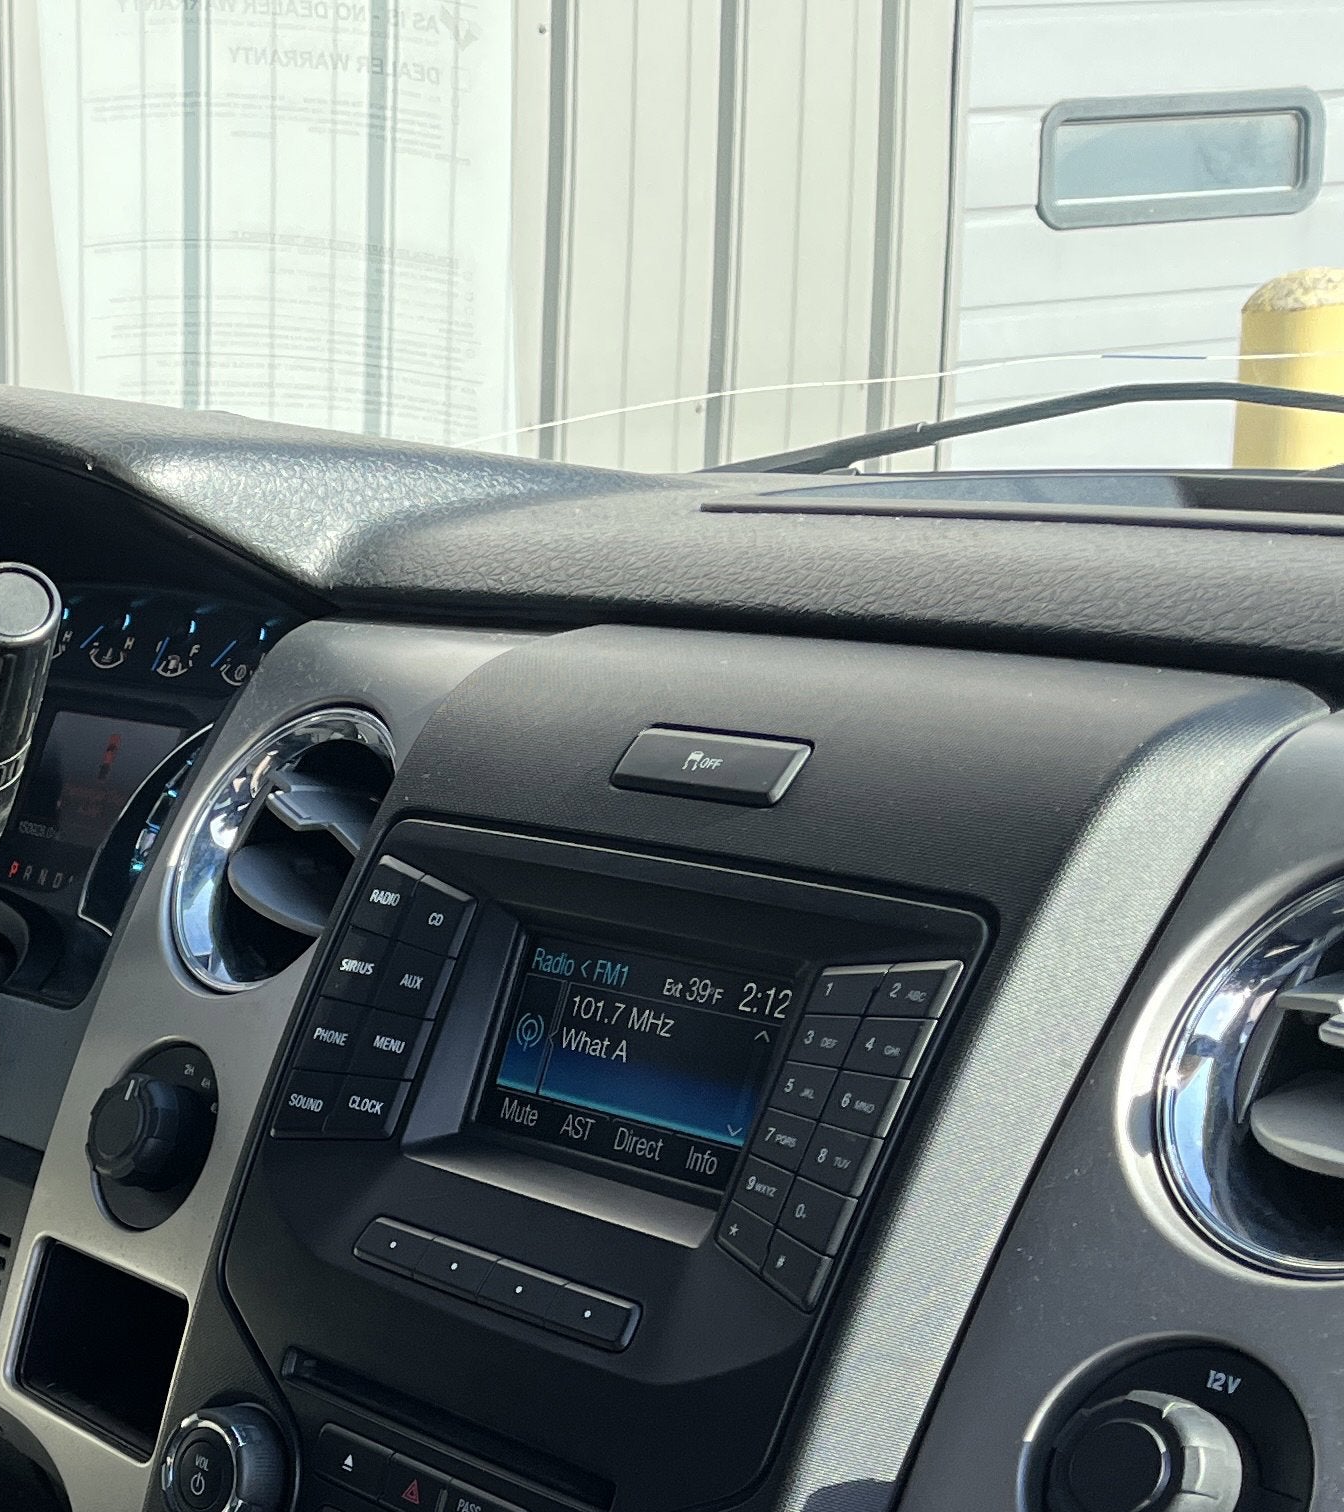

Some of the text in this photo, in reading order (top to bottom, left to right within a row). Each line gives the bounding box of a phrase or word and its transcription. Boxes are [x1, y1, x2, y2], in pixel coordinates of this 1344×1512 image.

[699, 757, 723, 770] OFF
[369, 889, 401, 907] RADIO
[428, 912, 444, 927] CD
[339, 958, 375, 975] SIRIUS
[531, 948, 575, 977] Radio
[592, 960, 630, 988] FM1
[399, 973, 423, 990] AUX
[824, 981, 834, 997] 1
[889, 982, 902, 999] 2
[738, 982, 793, 1019] 2:12
[572, 995, 675, 1038] 101.7 MHz
[313, 1027, 349, 1047] PHONE
[372, 1034, 406, 1055] MENU
[561, 1026, 628, 1063] What A
[803, 1030, 815, 1045] 3
[864, 1037, 876, 1051] 4
[783, 1078, 796, 1093] 5
[288, 1093, 324, 1113] SOUND
[348, 1095, 385, 1116] CLOCK
[841, 1092, 853, 1108] 6
[500, 1096, 719, 1176] Mute AST Direct Info
[764, 1127, 776, 1142] 7
[817, 1148, 829, 1163] 8
[746, 1175, 757, 1191] 9
[1205, 1369, 1242, 1394] 12V
[195, 1454, 209, 1472] VOL
